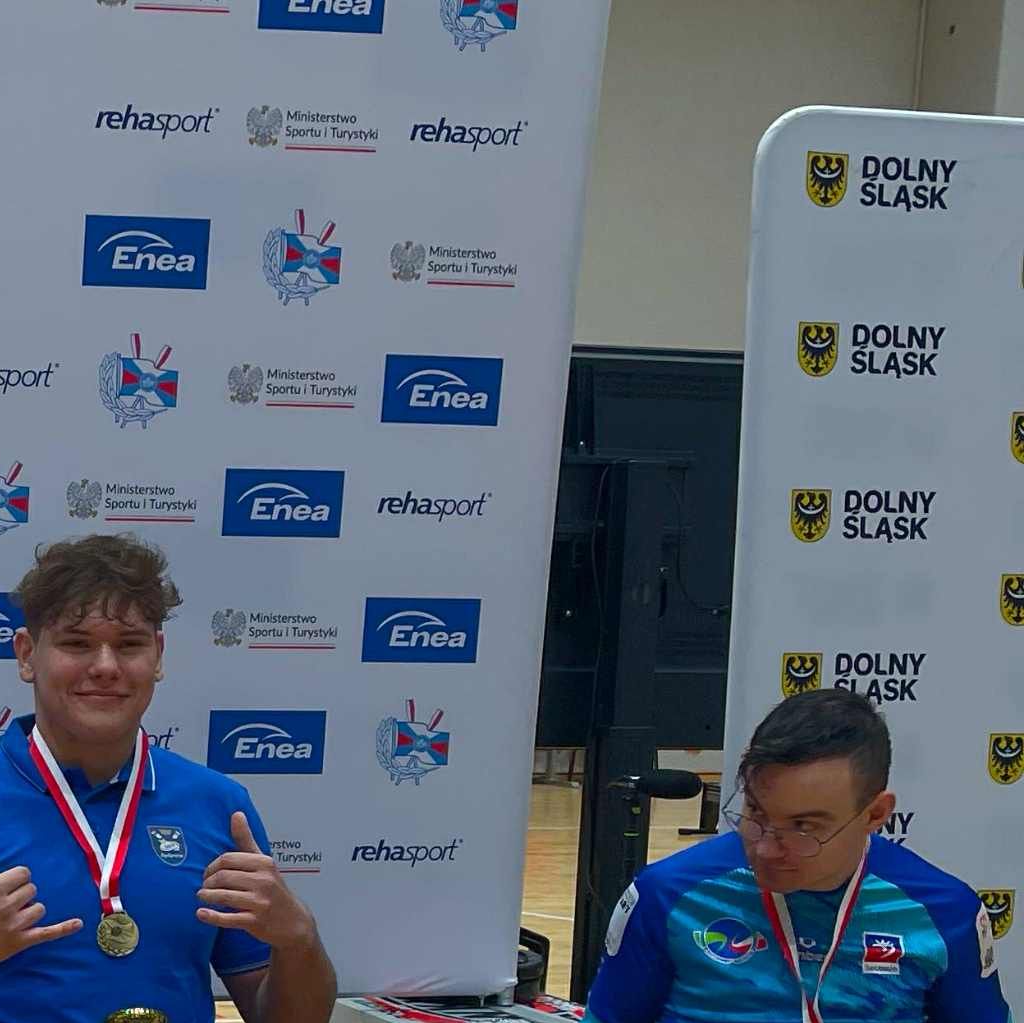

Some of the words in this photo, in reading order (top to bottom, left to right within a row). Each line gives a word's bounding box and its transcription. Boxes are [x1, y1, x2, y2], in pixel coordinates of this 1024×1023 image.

[287, 110, 357, 124] Ministerstwo
[285, 125, 321, 139] Sportu
[330, 127, 378, 142] Turystyki
[862, 156, 957, 183] DOLNY
[860, 177, 948, 212] ŚLĄSK
[112, 246, 195, 271] Enea
[429, 246, 496, 260] Ministerstwo
[427, 260, 462, 274] Sportu
[471, 262, 517, 277] Turystyki
[852, 324, 946, 349] DOLNY
[850, 345, 938, 379] ŚLĄSK
[267, 369, 335, 381] Ministerstwo
[266, 383, 301, 396] Sportu
[310, 384, 357, 398] Turystyki
[410, 385, 488, 408] Enea
[106, 483, 175, 496] Ministerstwo
[105, 497, 140, 511] Sportu
[149, 498, 197, 512] Turystyki
[251, 498, 329, 521] Enea
[844, 490, 936, 513] DOLNY
[843, 511, 928, 543] ŚLĄSK
[250, 613, 317, 624] Ministerstwo
[249, 626, 283, 638] Sportu
[292, 627, 337, 640] Turystyki
[389, 625, 466, 647] Enea
[835, 653, 926, 676] DOLNY
[235, 738, 312, 758] Enea
[277, 851, 322, 864] Turystyki
